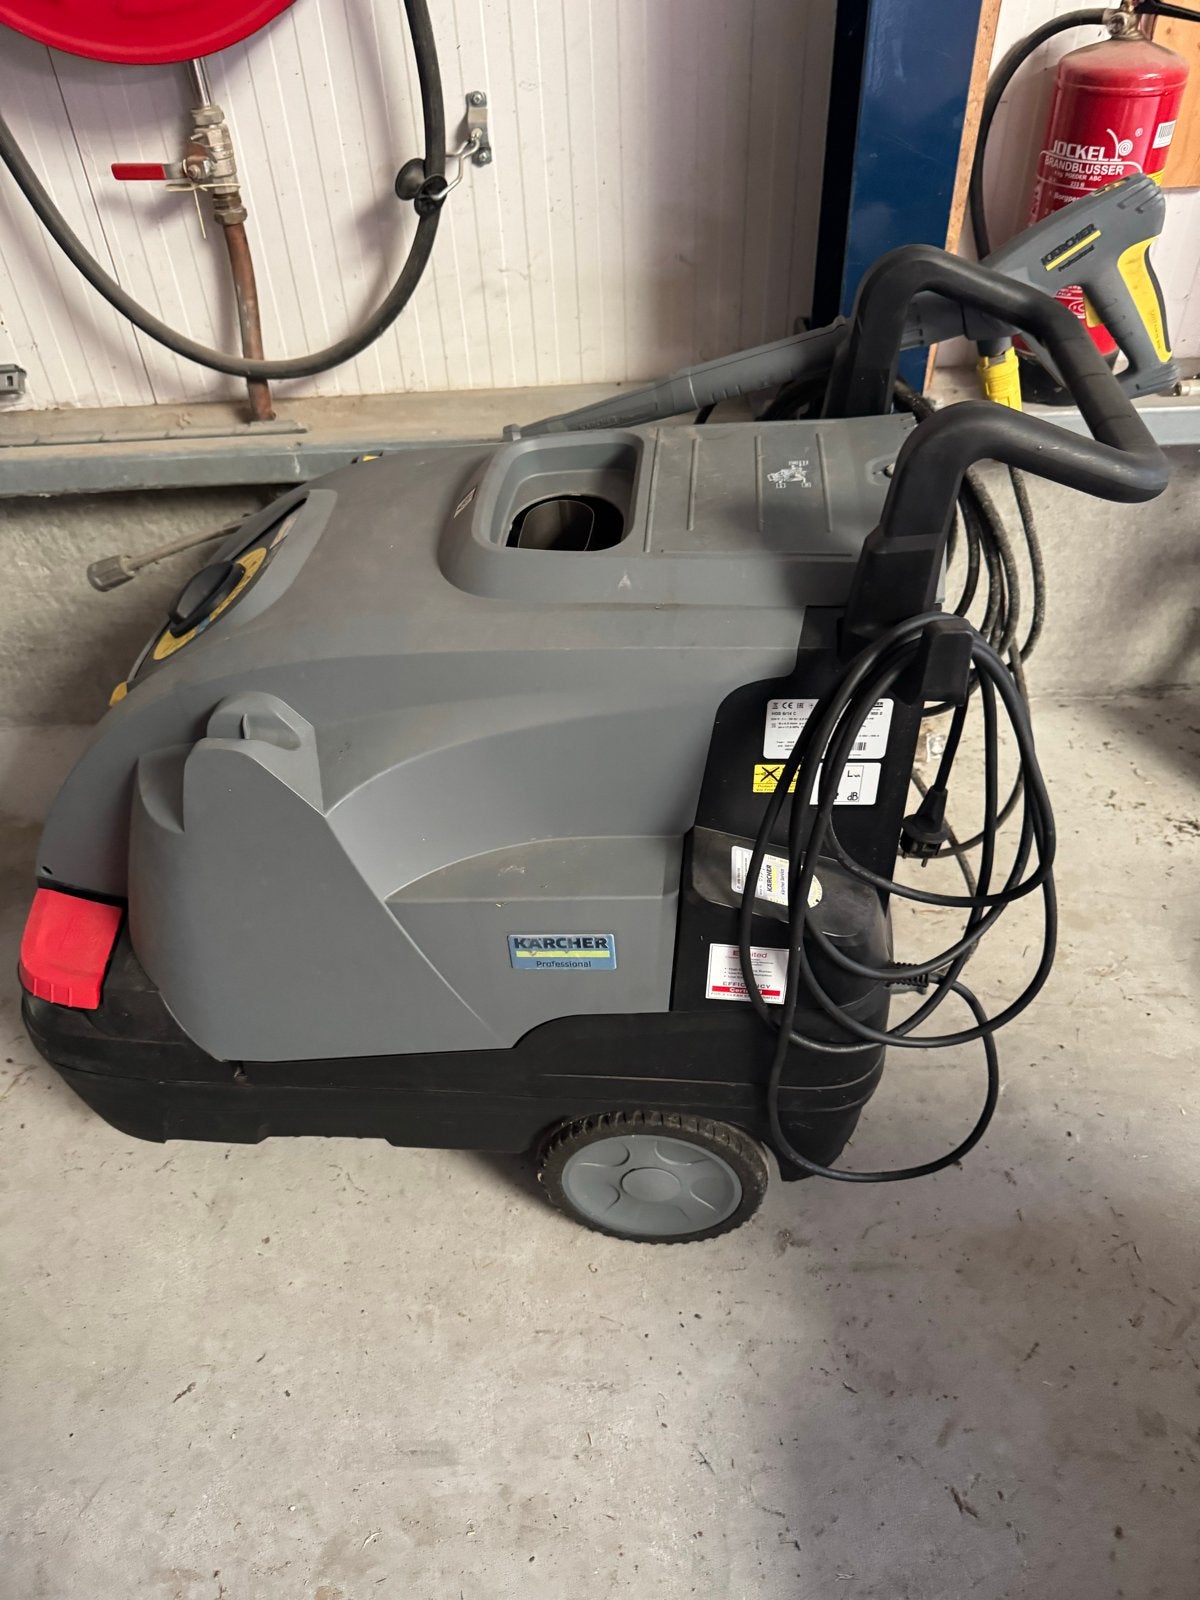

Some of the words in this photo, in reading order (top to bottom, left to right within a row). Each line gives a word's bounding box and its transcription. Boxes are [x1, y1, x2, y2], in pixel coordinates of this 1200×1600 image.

[1051, 140, 1109, 162] JOCKEL
[1044, 155, 1124, 176] BRANDBLUSSER
[847, 791, 859, 801] dB
[536, 960, 592, 968] Professional
